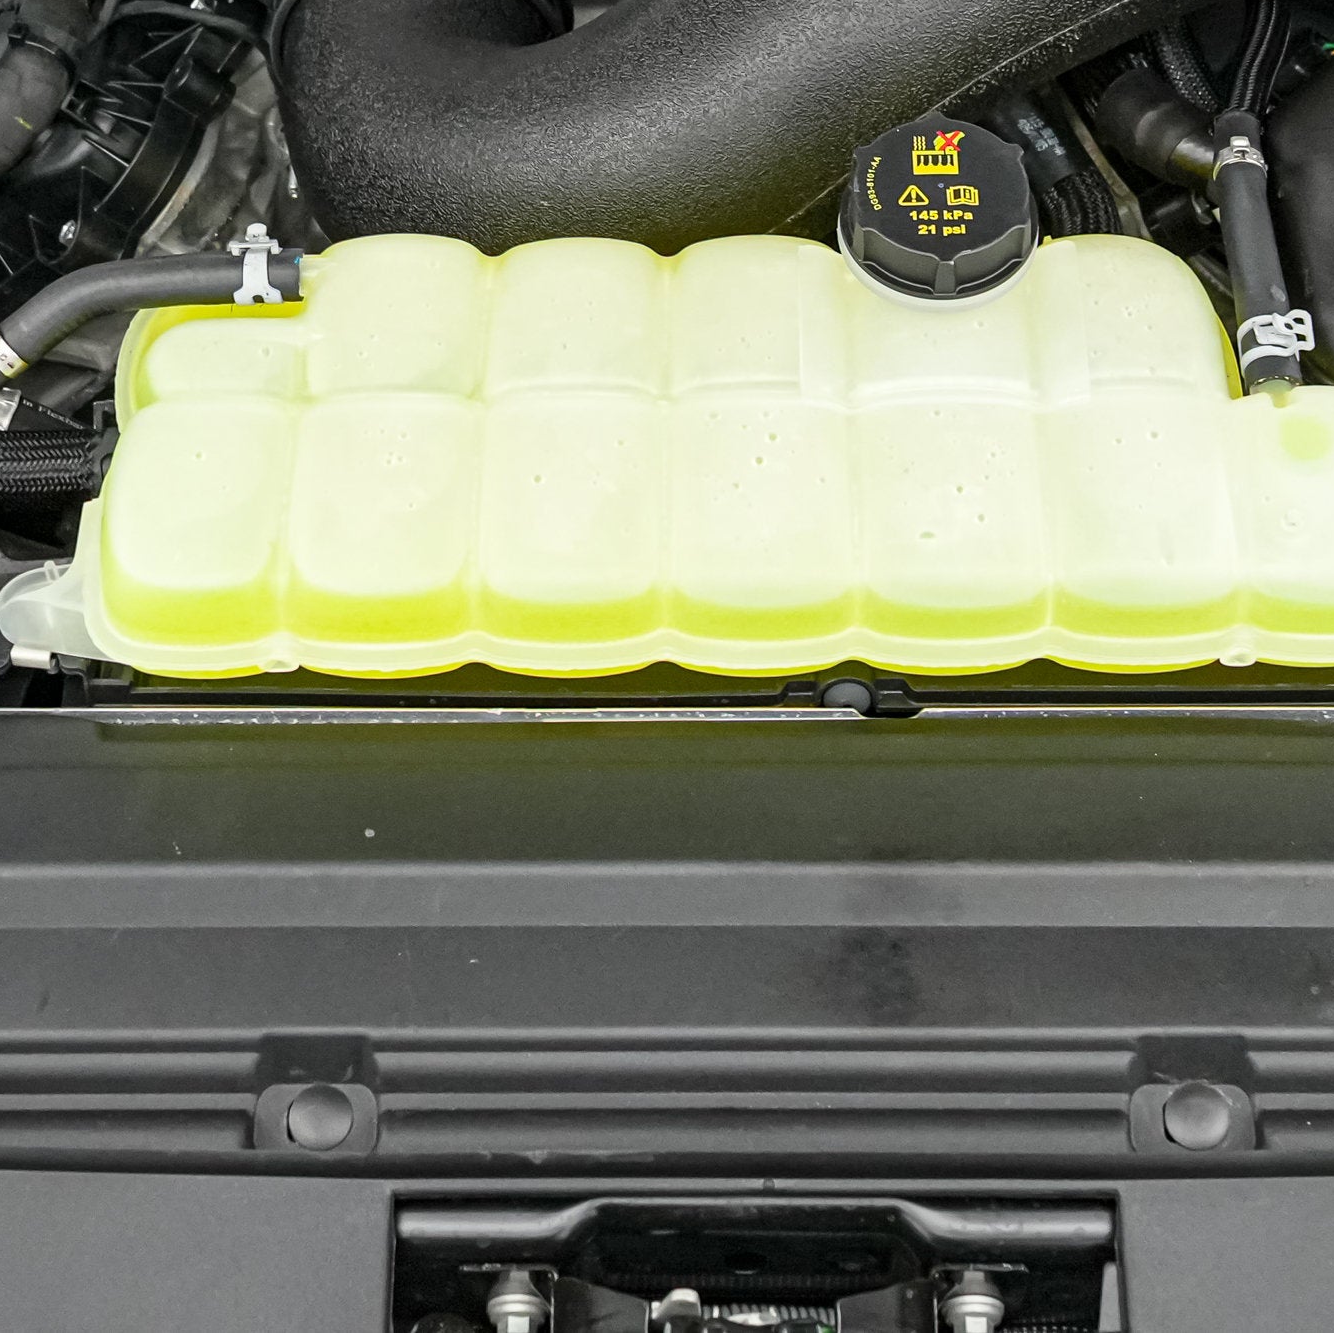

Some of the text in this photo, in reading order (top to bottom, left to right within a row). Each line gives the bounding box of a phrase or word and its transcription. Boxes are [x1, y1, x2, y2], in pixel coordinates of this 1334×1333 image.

[866, 156, 882, 211] DG93-8101-AA
[909, 209, 974, 221] 145 kPa
[917, 224, 967, 236] 21 psi
